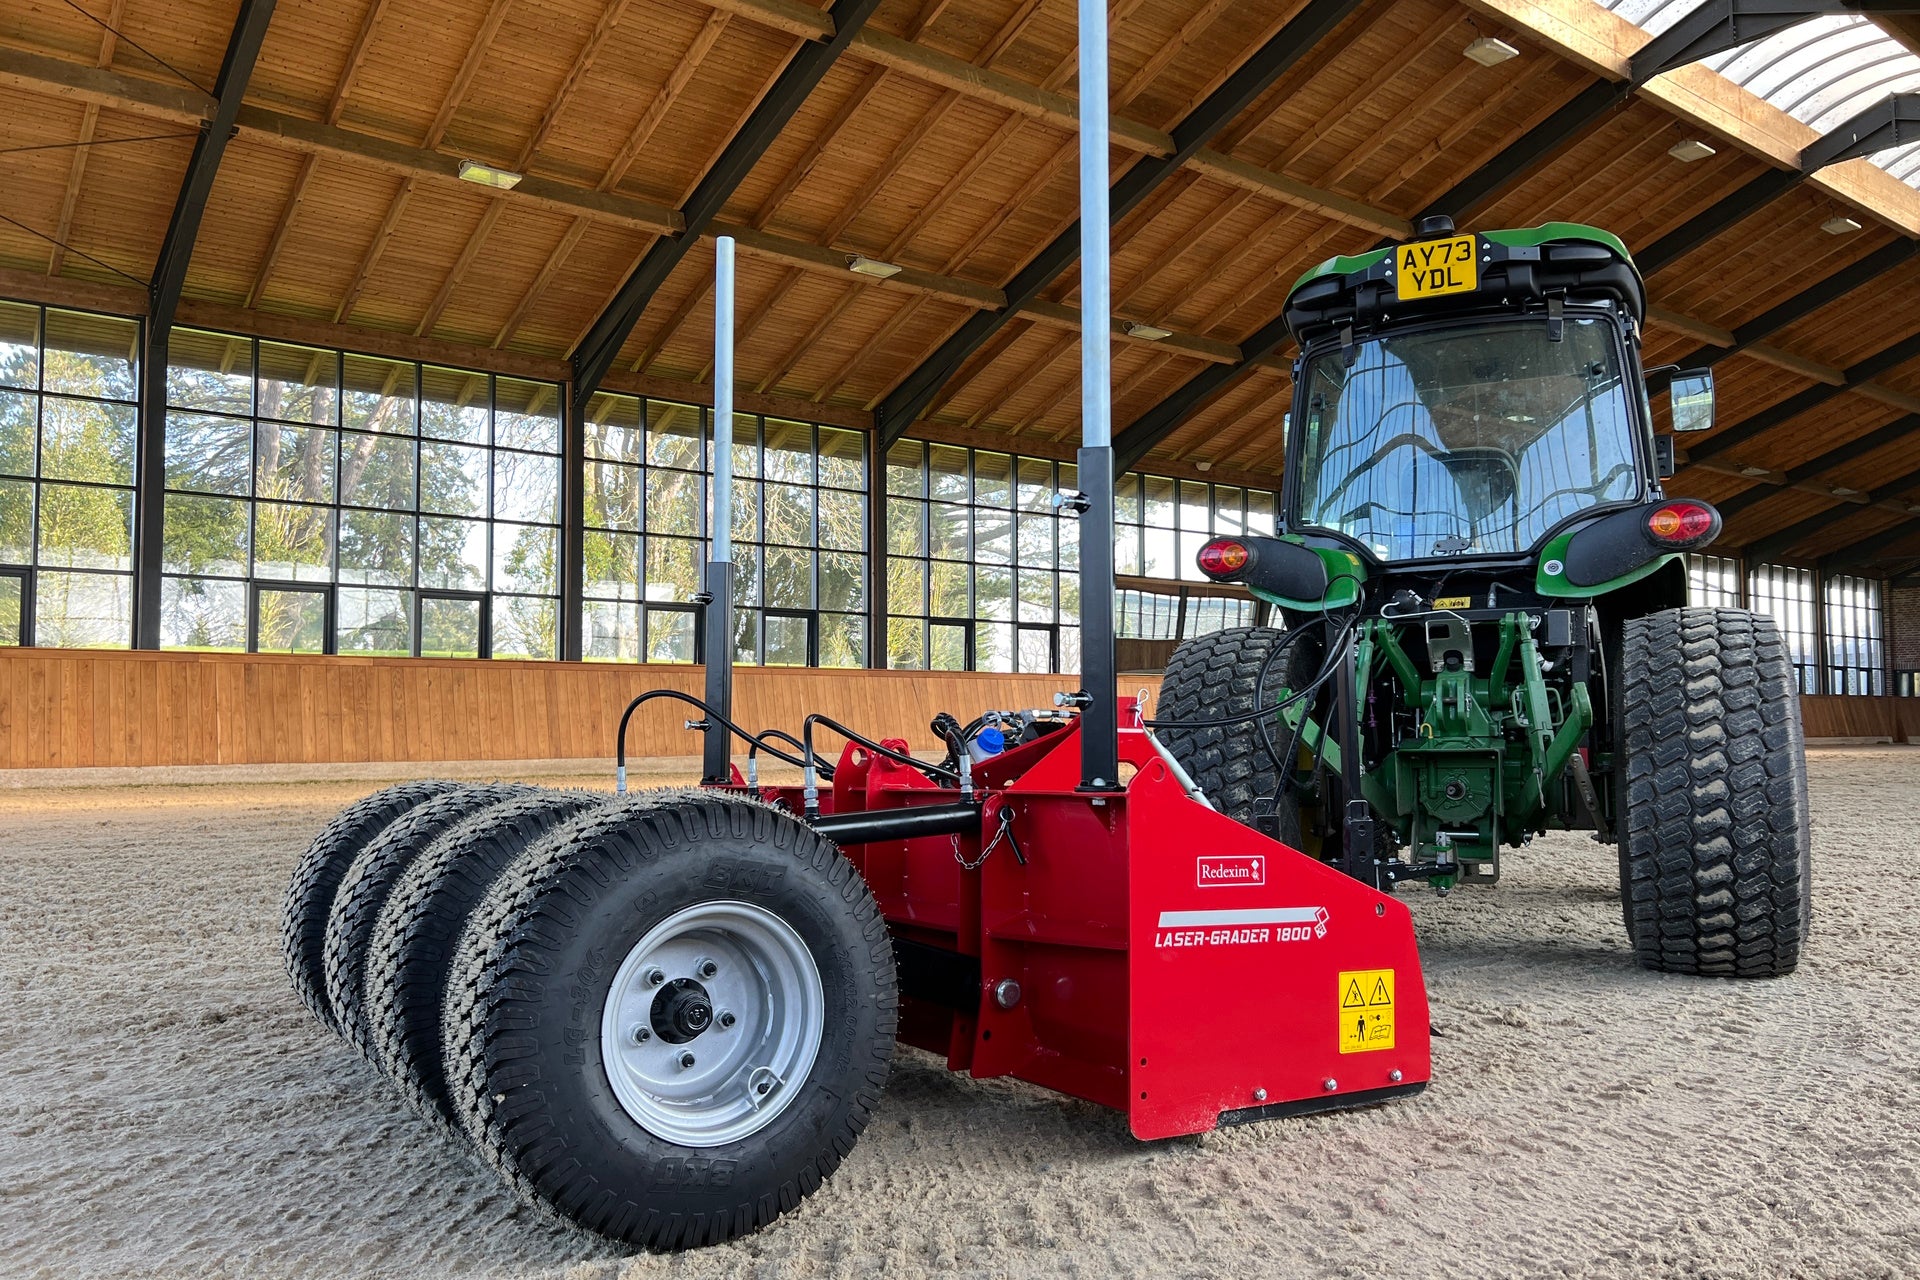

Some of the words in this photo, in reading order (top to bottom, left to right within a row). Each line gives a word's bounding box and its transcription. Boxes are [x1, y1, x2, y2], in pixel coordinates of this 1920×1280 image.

[1403, 241, 1471, 270] AY73
[1412, 267, 1463, 291] YDL
[1202, 864, 1249, 879] Redexim
[1155, 929, 1270, 948] LASER-GRADER
[1276, 927, 1311, 941] 1800
